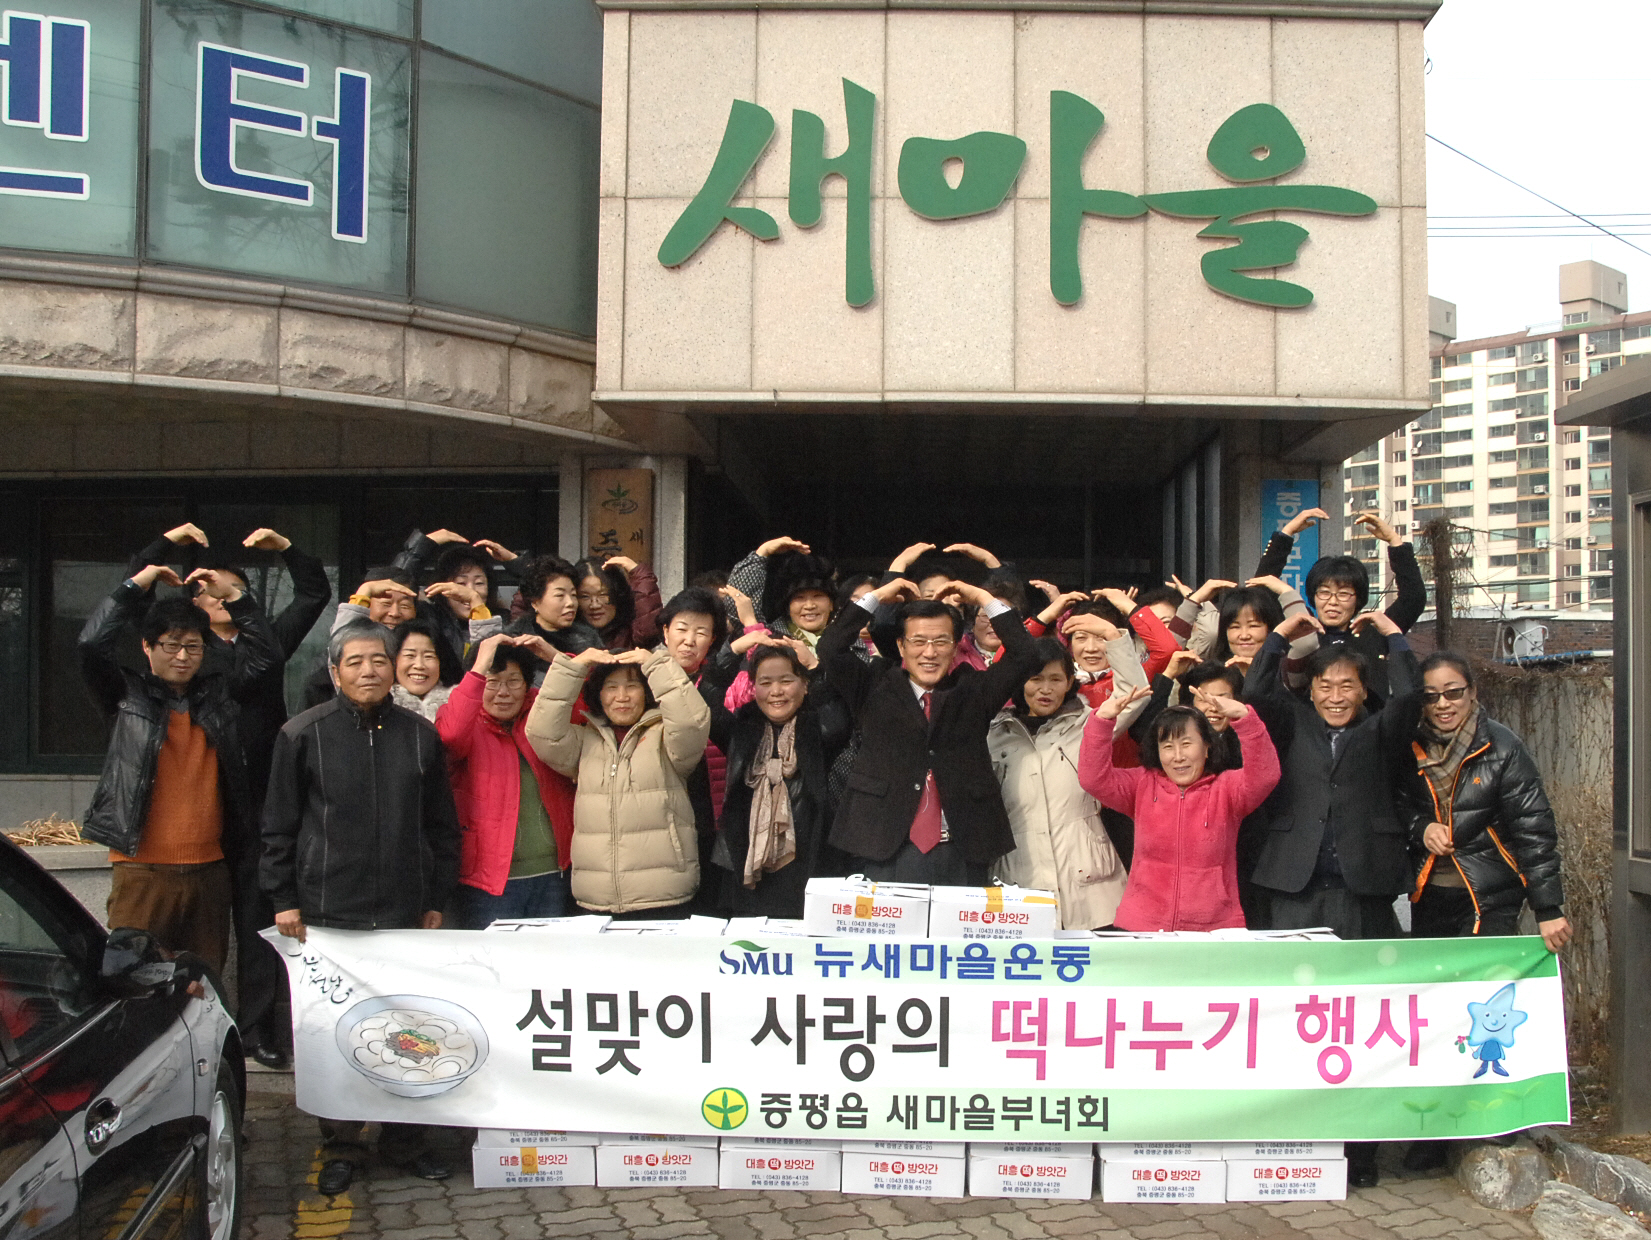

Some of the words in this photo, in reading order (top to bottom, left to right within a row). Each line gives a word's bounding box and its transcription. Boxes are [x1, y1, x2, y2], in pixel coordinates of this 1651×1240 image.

[657, 77, 1378, 308] 새마을
[832, 904, 852, 915] 대흥
[872, 906, 902, 918] 방앗간
[959, 911, 979, 922] 대흥
[998, 913, 1029, 924] 방앗간
[814, 943, 1091, 983] 뉴새마을운동
[515, 989, 711, 1076] 설맞이
[751, 994, 950, 1082] 사랑의
[992, 997, 1259, 1080] 떡나누기
[1295, 994, 1428, 1084] 행사
[760, 1091, 869, 1130] 증평읍
[886, 1092, 1108, 1132] 새마을부녀회
[500, 1156, 519, 1166] 대흥
[538, 1155, 568, 1165] 방앗간
[624, 1155, 643, 1165] 대흥
[746, 1159, 765, 1169] 대흥
[784, 1160, 814, 1170] 방앗간
[870, 1162, 889, 1172] 대흥
[908, 1163, 938, 1174] 방앗간
[998, 1165, 1017, 1175] 대흥
[1037, 1166, 1066, 1177] 방앗간
[1254, 1168, 1273, 1178] 대흥
[1292, 1168, 1321, 1178] 방앗간
[1133, 1170, 1152, 1180] 대흥
[1171, 1170, 1201, 1180] 방앗간
